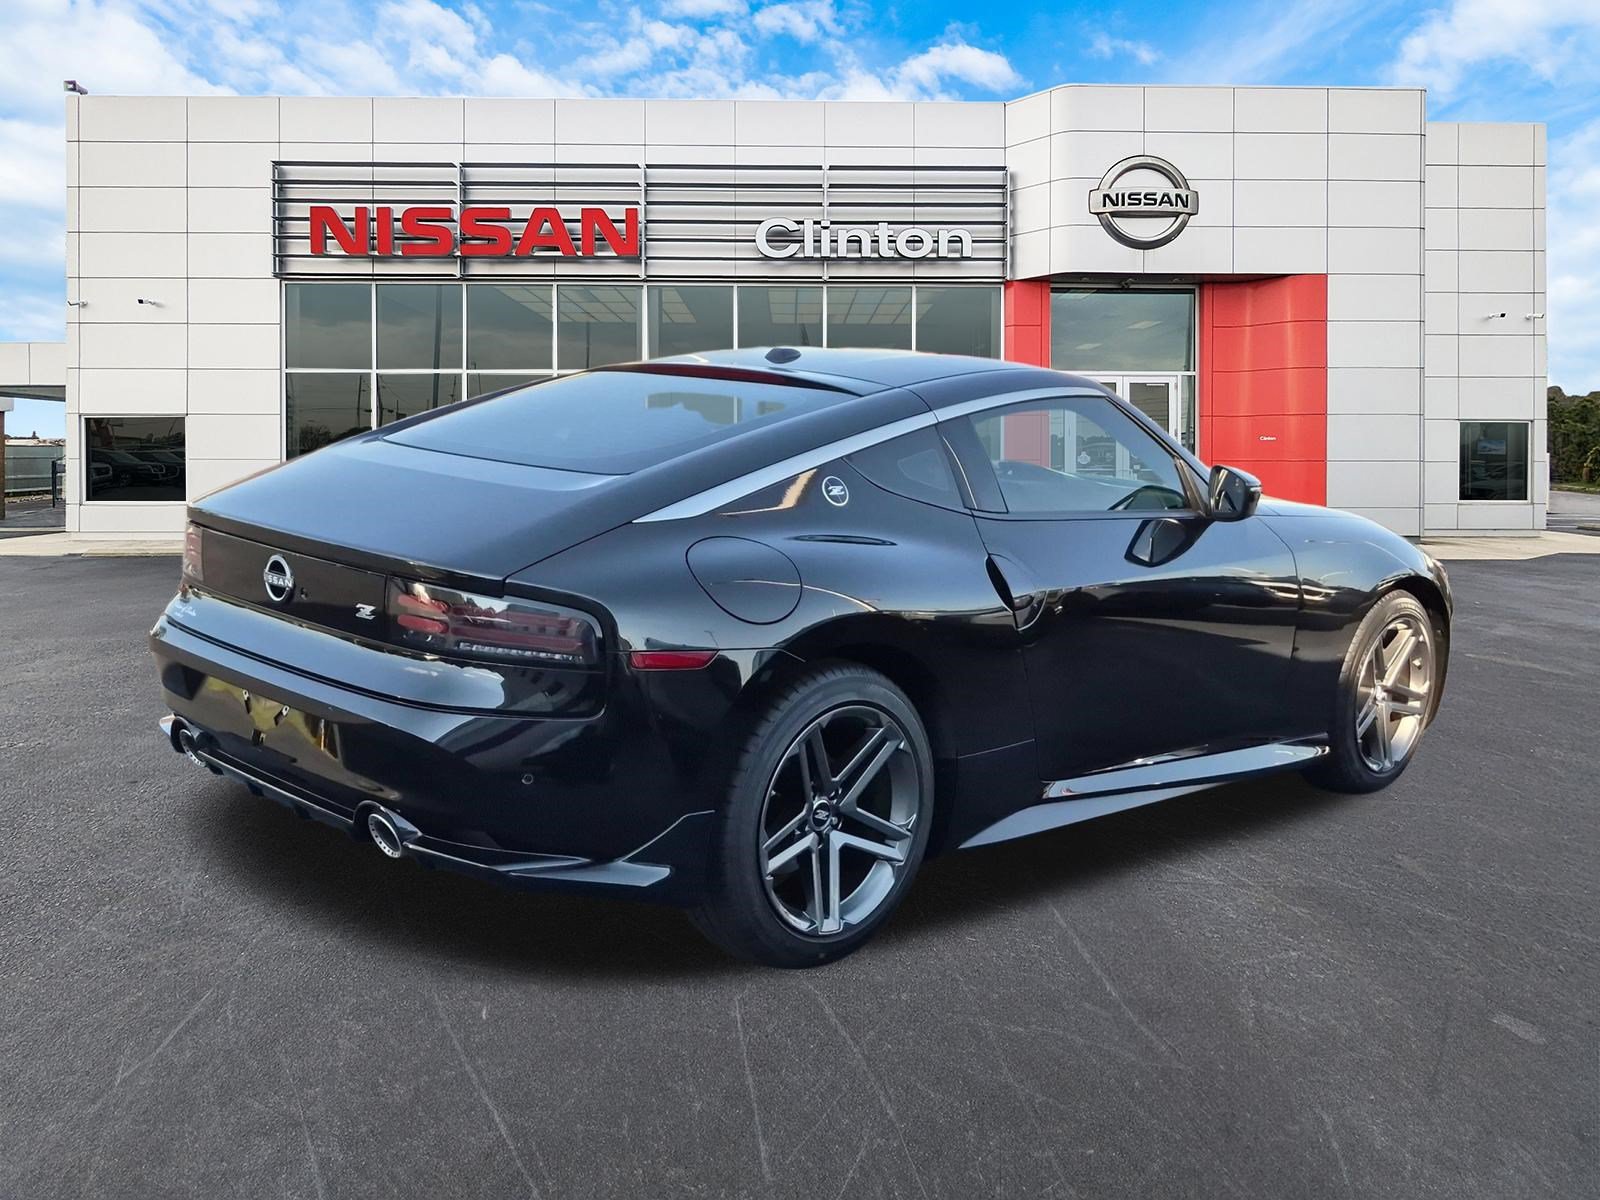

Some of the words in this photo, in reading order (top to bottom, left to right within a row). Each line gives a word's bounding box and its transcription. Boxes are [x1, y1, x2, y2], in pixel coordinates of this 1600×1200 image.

[1102, 191, 1189, 209] NISSAN
[309, 206, 640, 257] NISSAN
[755, 217, 973, 259] Clinton
[266, 573, 293, 588] SSAN
[354, 602, 377, 620] Z
